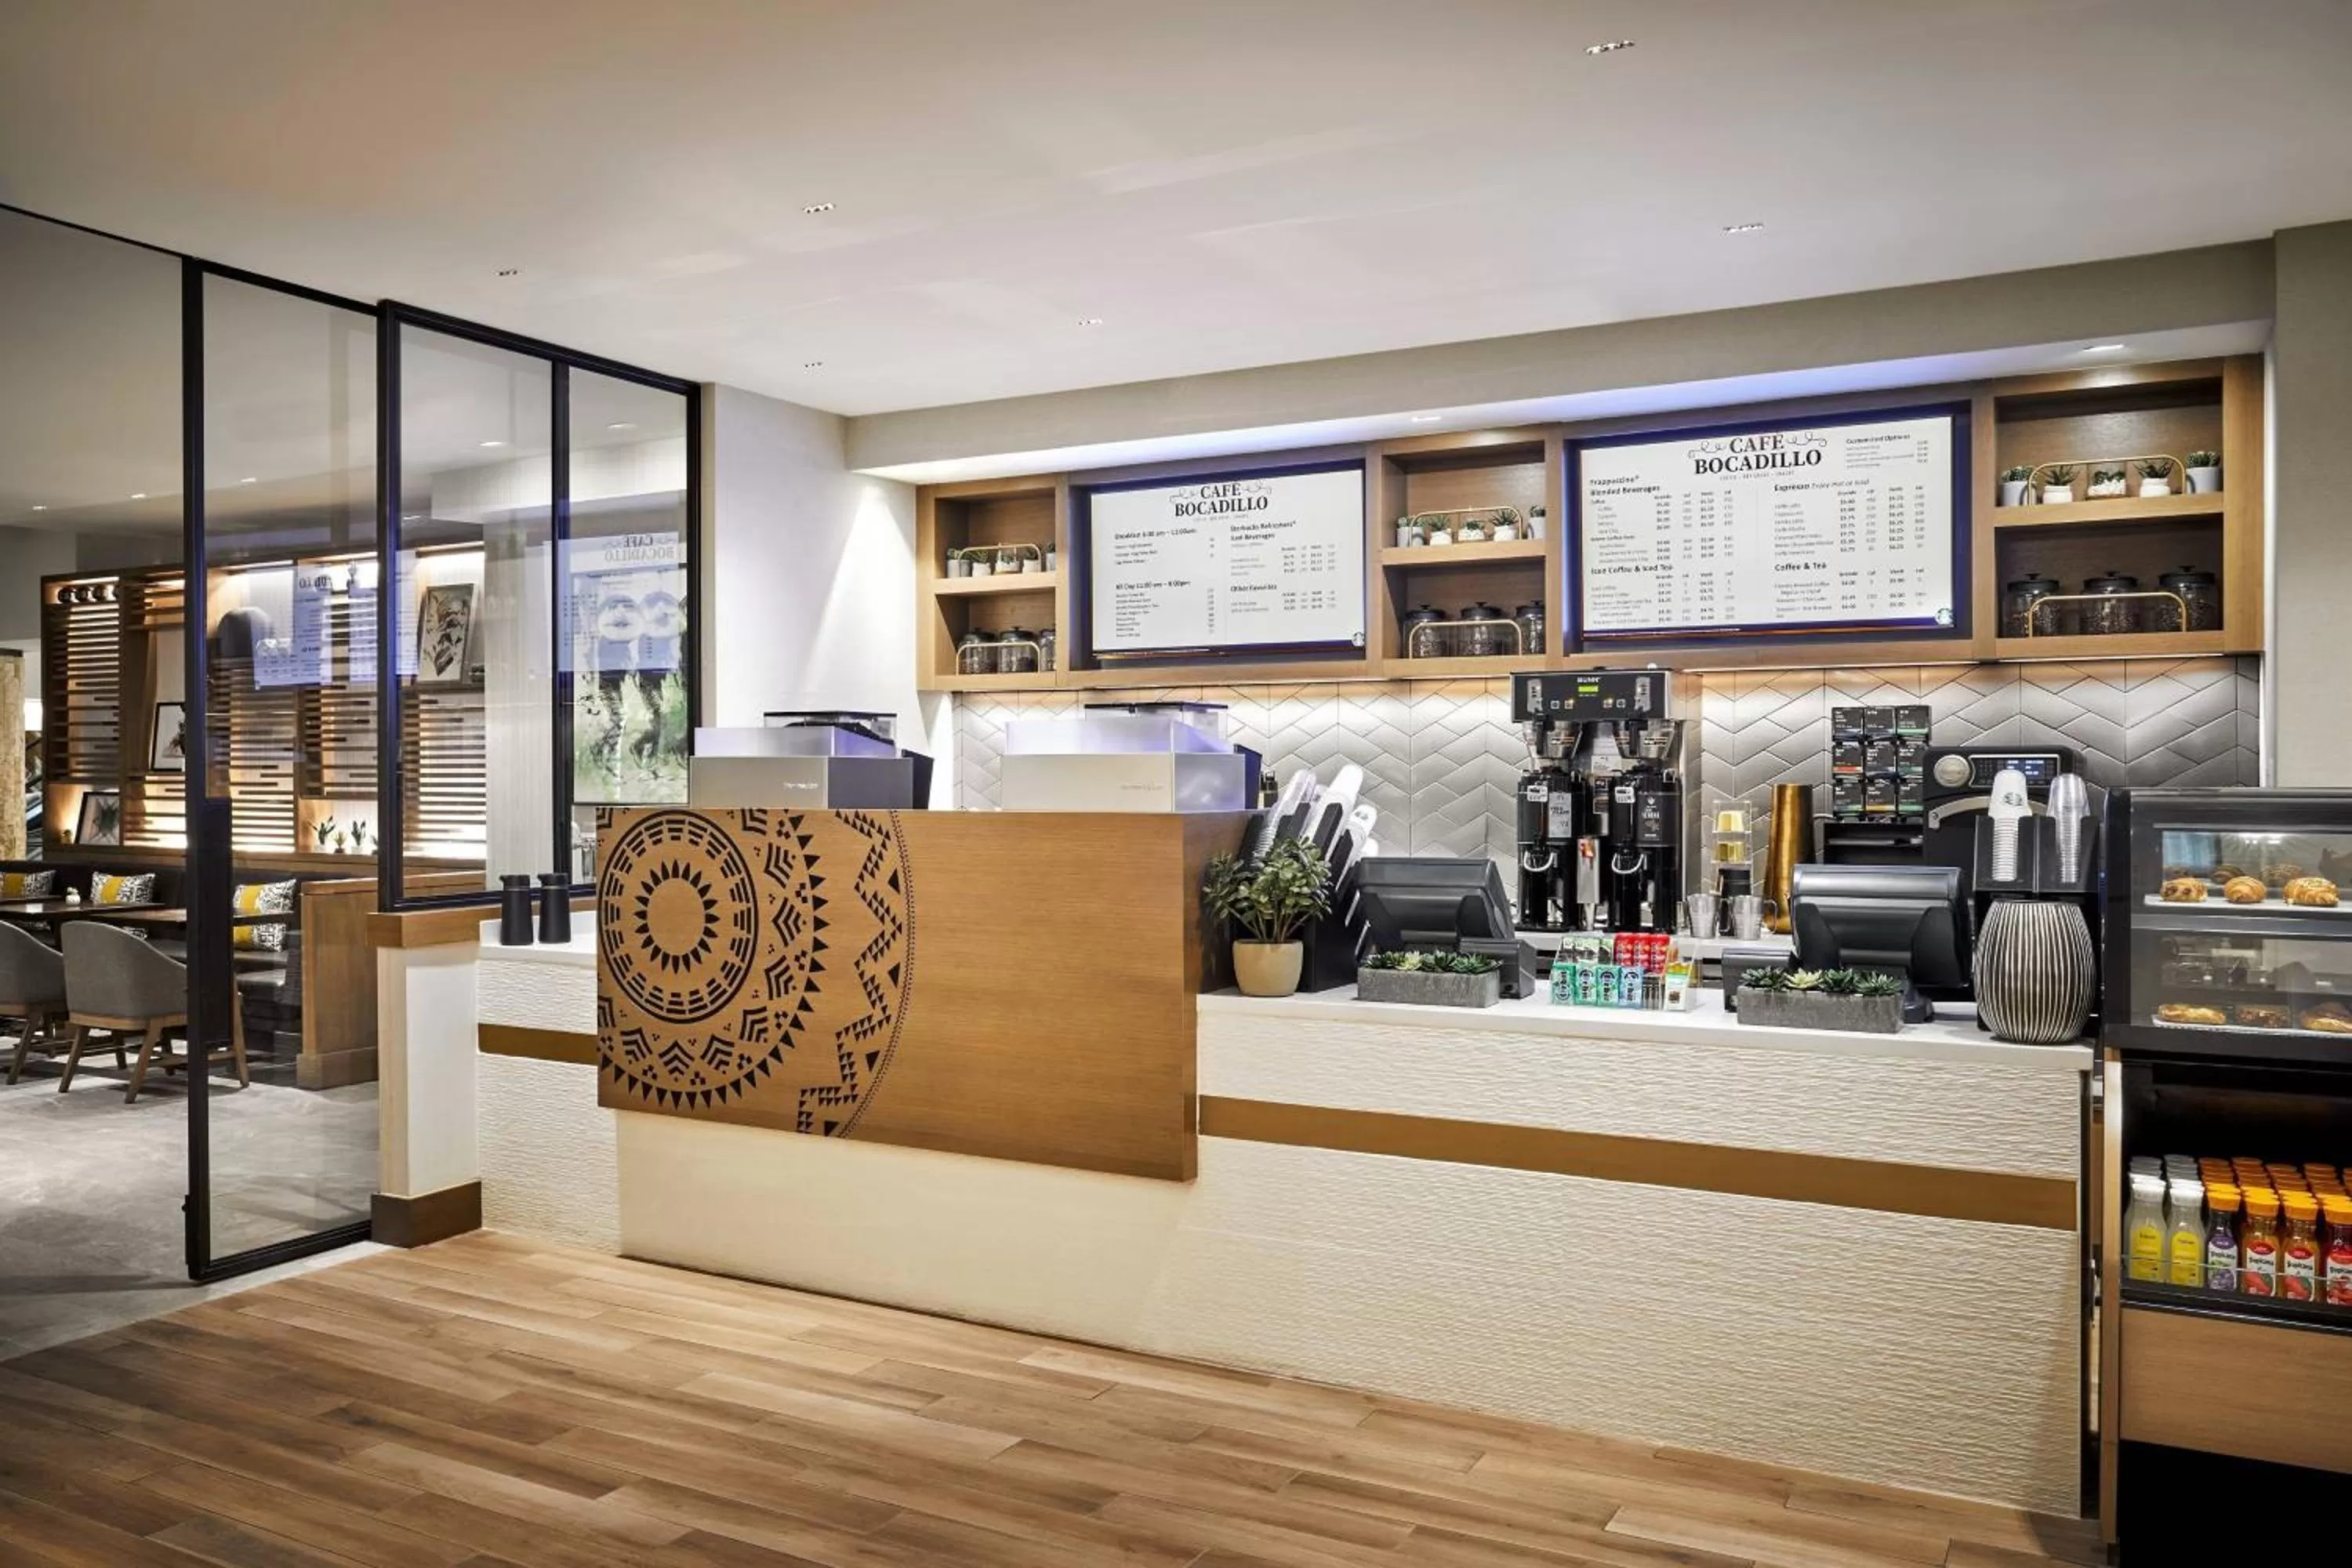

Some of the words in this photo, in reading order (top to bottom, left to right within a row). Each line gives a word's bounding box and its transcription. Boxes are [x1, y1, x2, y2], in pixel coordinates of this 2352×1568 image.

[1730, 434, 1784, 454] CAFE
[1694, 449, 1821, 474] BOCADILLO
[1200, 483, 1241, 499] CAFE
[1591, 487, 1621, 496] Blended
[1622, 485, 1660, 494] Beverages
[1175, 495, 1268, 517] BOCADILLO
[2249, 1257, 2274, 1265] Tropicana
[2287, 1261, 2313, 1270] Tropicana
